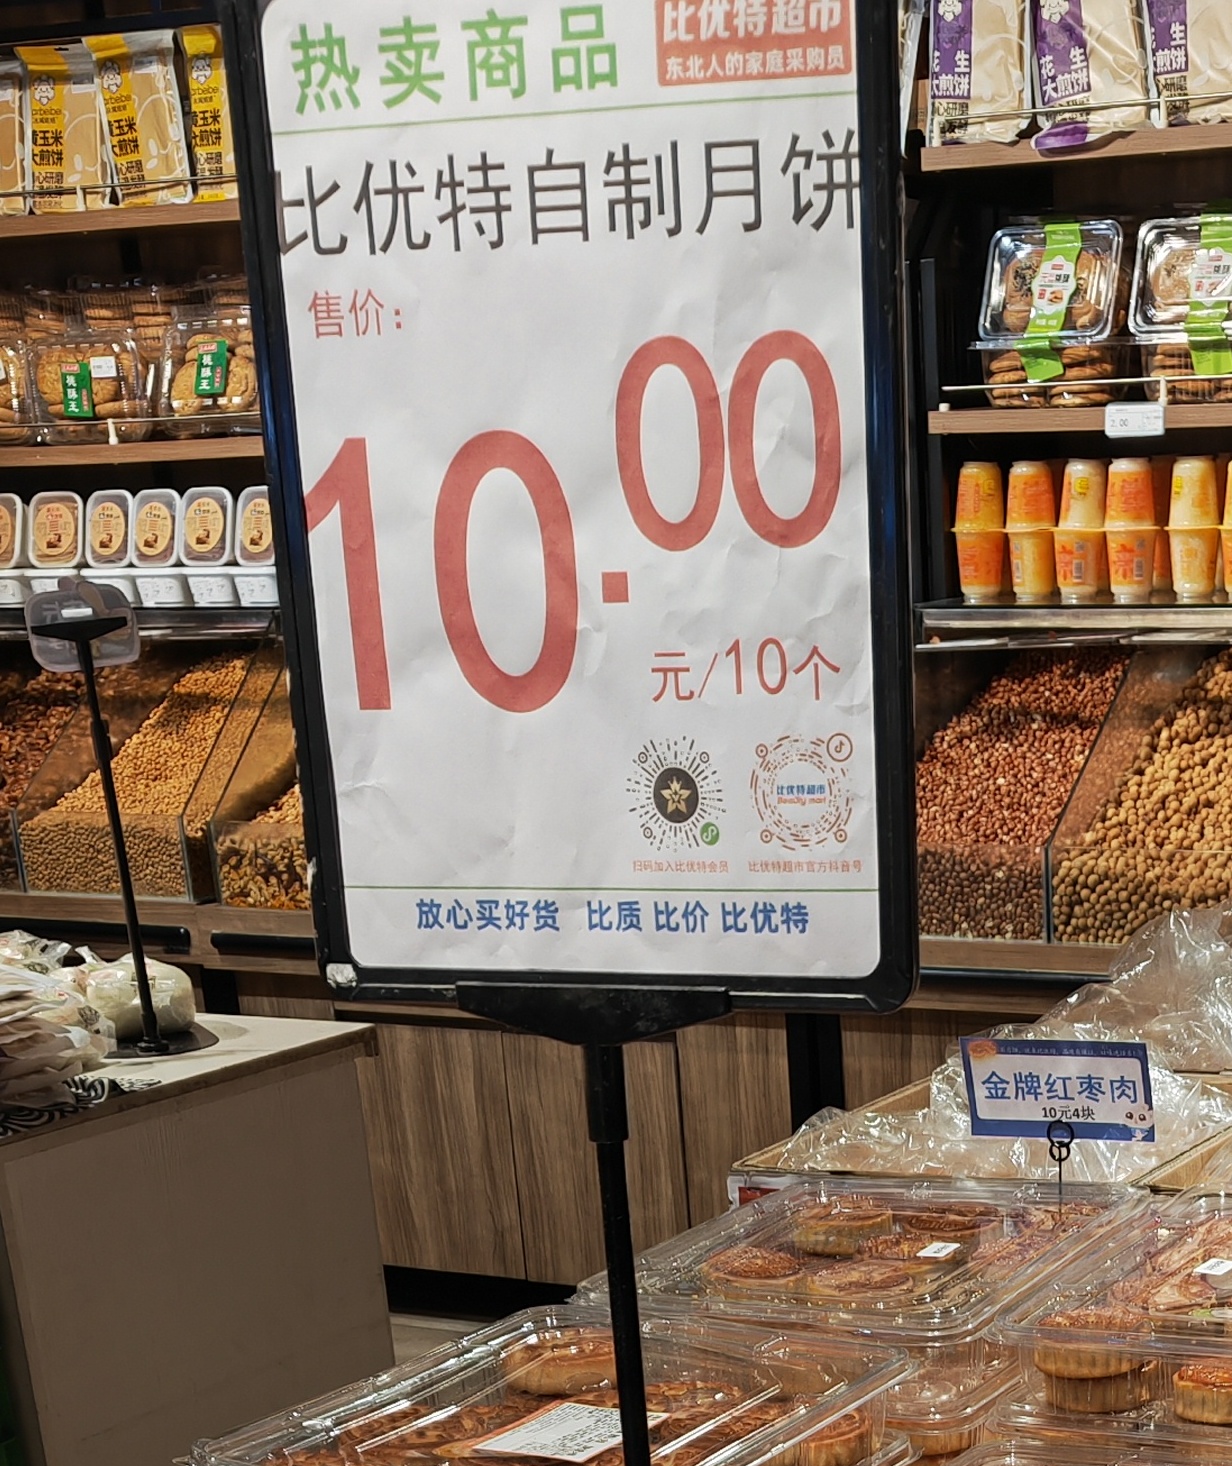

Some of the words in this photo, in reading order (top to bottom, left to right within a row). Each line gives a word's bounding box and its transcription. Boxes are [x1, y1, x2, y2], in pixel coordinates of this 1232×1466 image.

[662, 0, 844, 42] 比优特超市
[290, 6, 619, 116] 热卖商品
[665, 47, 845, 81] 东北人的家庭采购员
[1153, 46, 1186, 73] 煎饼
[1043, 68, 1088, 102] 大煎饼
[274, 126, 858, 256] 比优特自制月饼
[305, 329, 842, 713] 10.00
[651, 637, 841, 703] 元/10个
[633, 860, 729, 873] 扫码加入比优特会员
[748, 860, 862, 873] 比优特超市官方抖音号
[415, 899, 560, 933] 放心买好货
[586, 900, 643, 933] 比质
[653, 900, 709, 934] 比价
[721, 901, 809, 934] 比优特
[981, 1070, 1138, 1104] 金牌红枣肉
[1041, 1105, 1095, 1121] 10元4块
